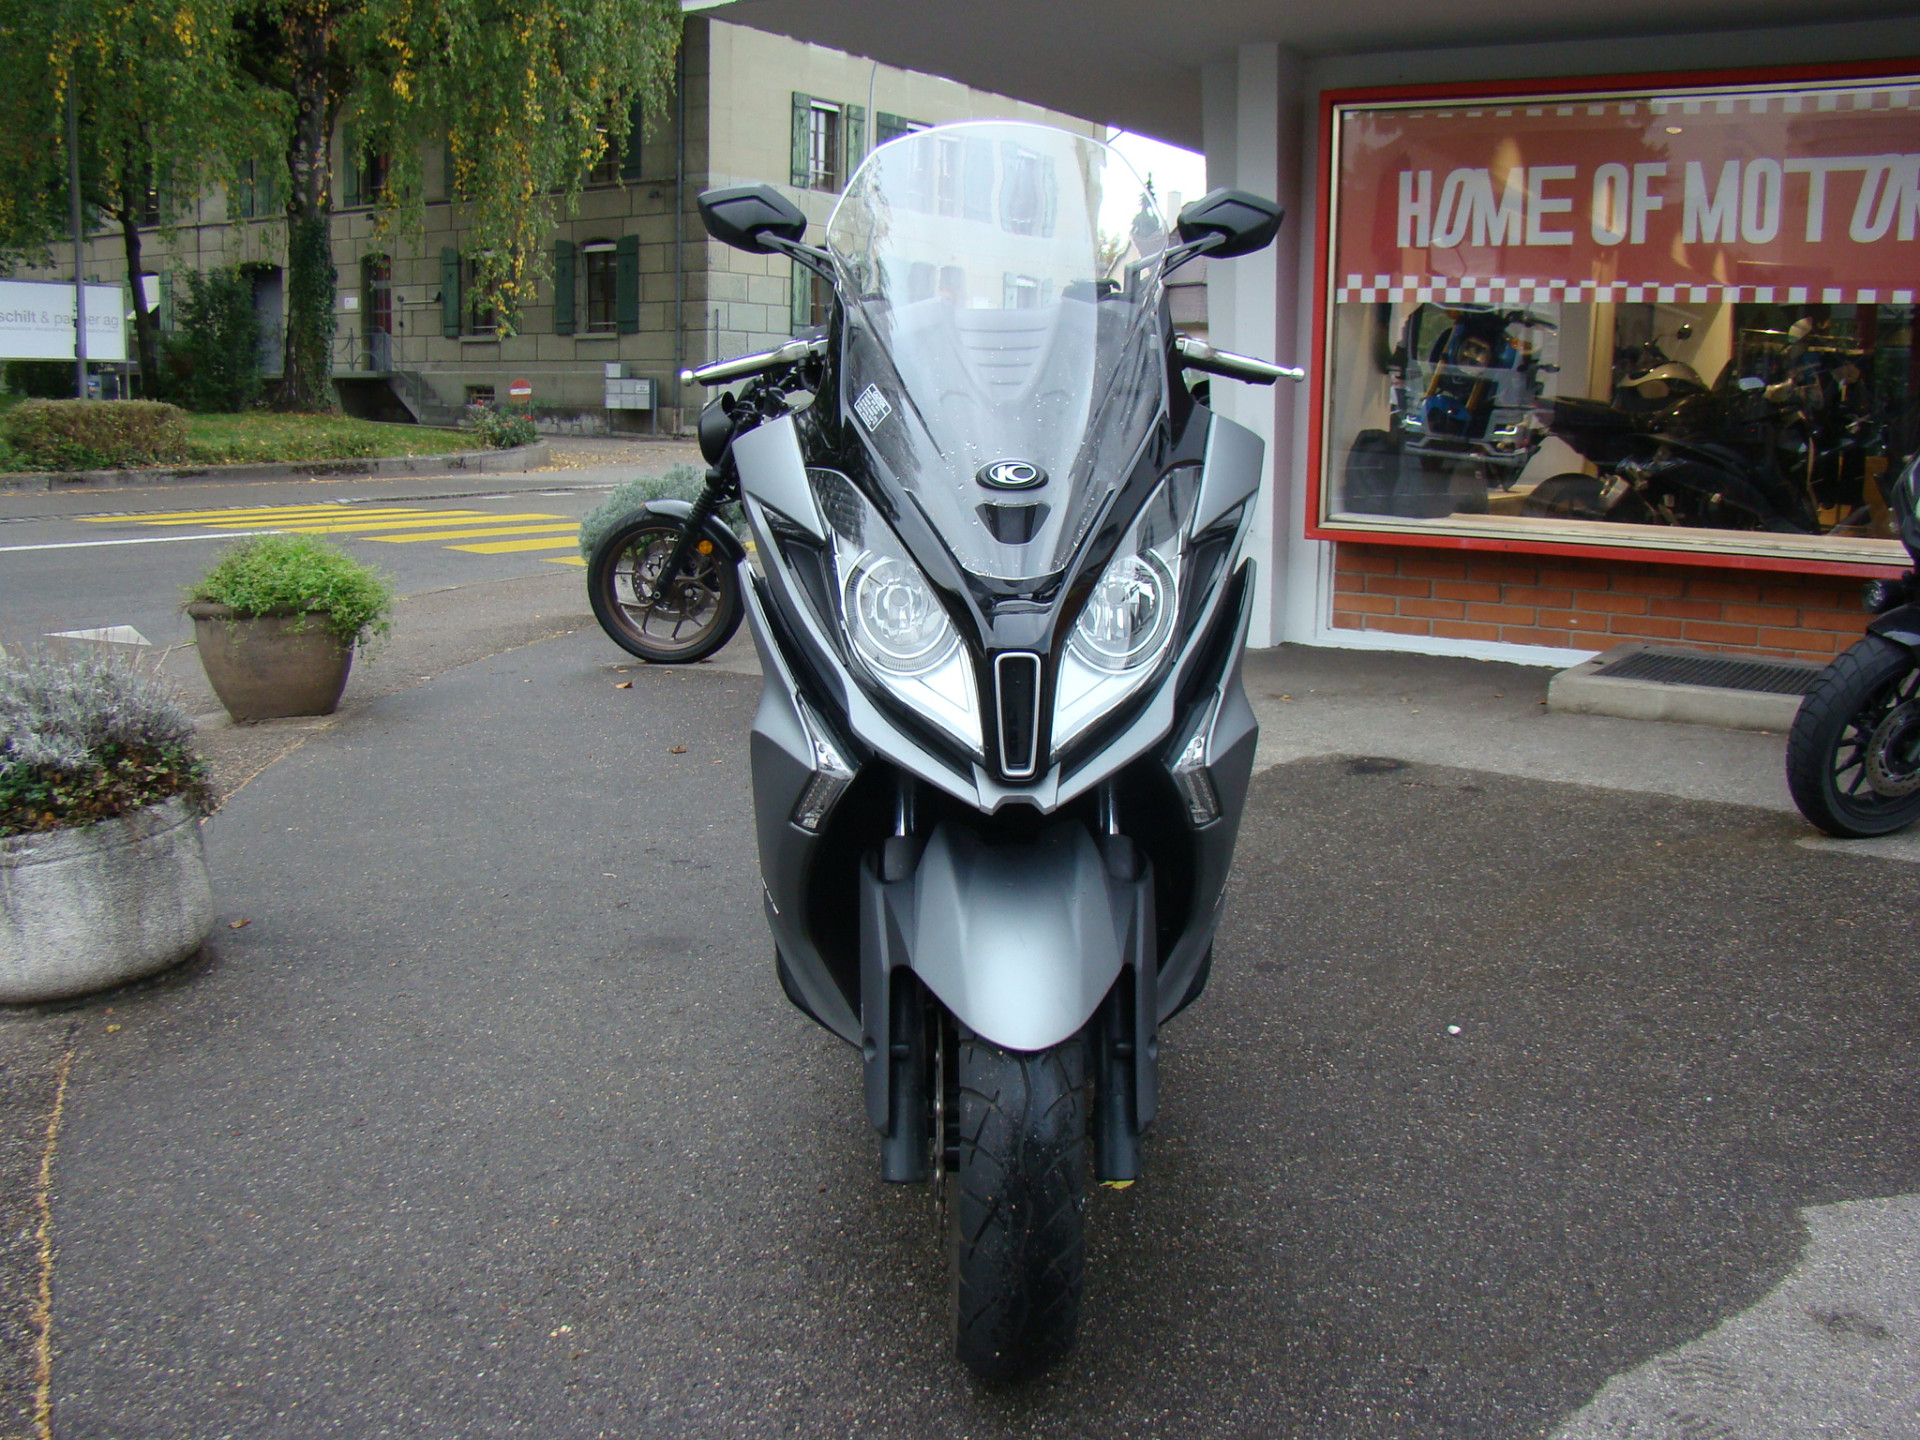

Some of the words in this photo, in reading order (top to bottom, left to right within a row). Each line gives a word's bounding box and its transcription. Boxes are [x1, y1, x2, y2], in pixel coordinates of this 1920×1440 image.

[1397, 164, 1577, 249] HOME
[1591, 162, 1668, 246] OF
[41, 311, 50, 324] &
[54, 314, 100, 327] parer
[103, 316, 119, 329] ag
